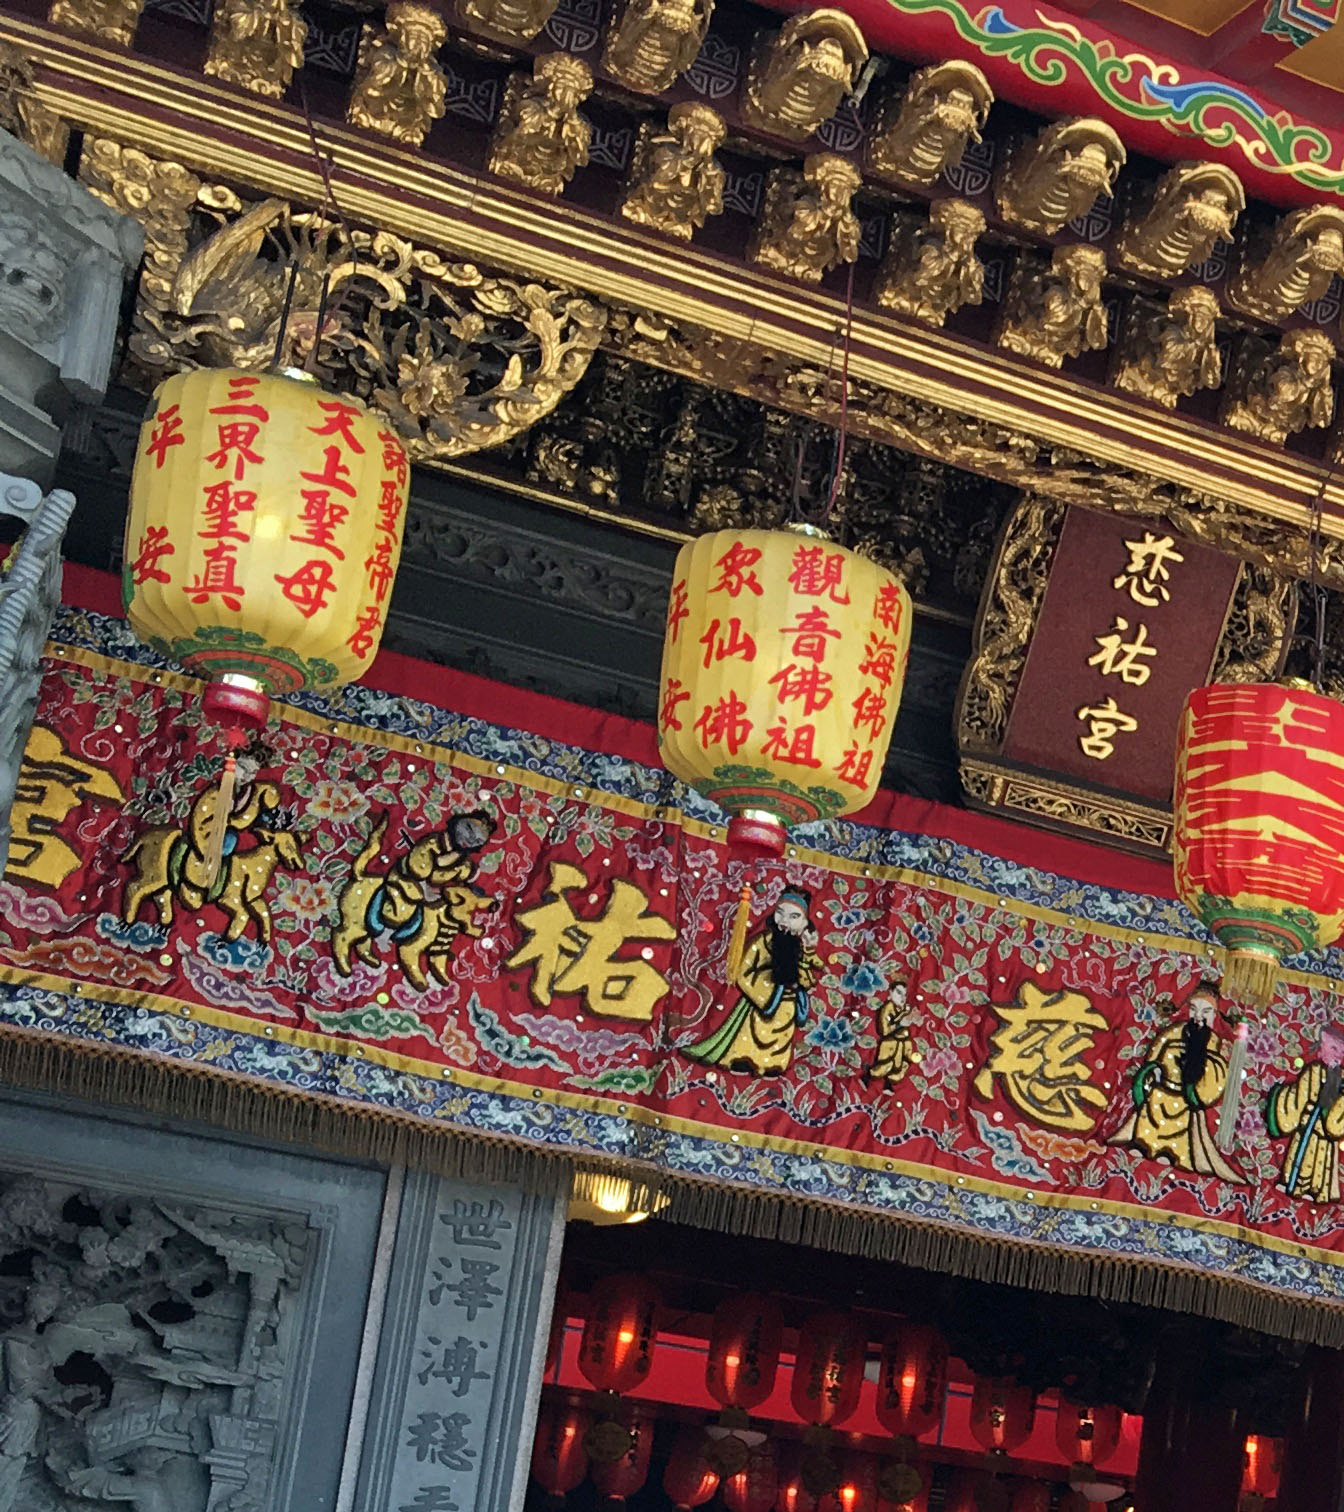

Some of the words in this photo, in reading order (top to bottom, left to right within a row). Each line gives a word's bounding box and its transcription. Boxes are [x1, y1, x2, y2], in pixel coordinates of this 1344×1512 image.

[131, 404, 185, 585] 平安
[183, 377, 269, 612] 三界聖真
[274, 400, 366, 617] 天上聖母
[660, 579, 690, 733] 平安
[760, 544, 850, 769] 觀音佛祖
[832, 579, 902, 791] 南海佛祖
[1078, 532, 1184, 760] 慈祐宮
